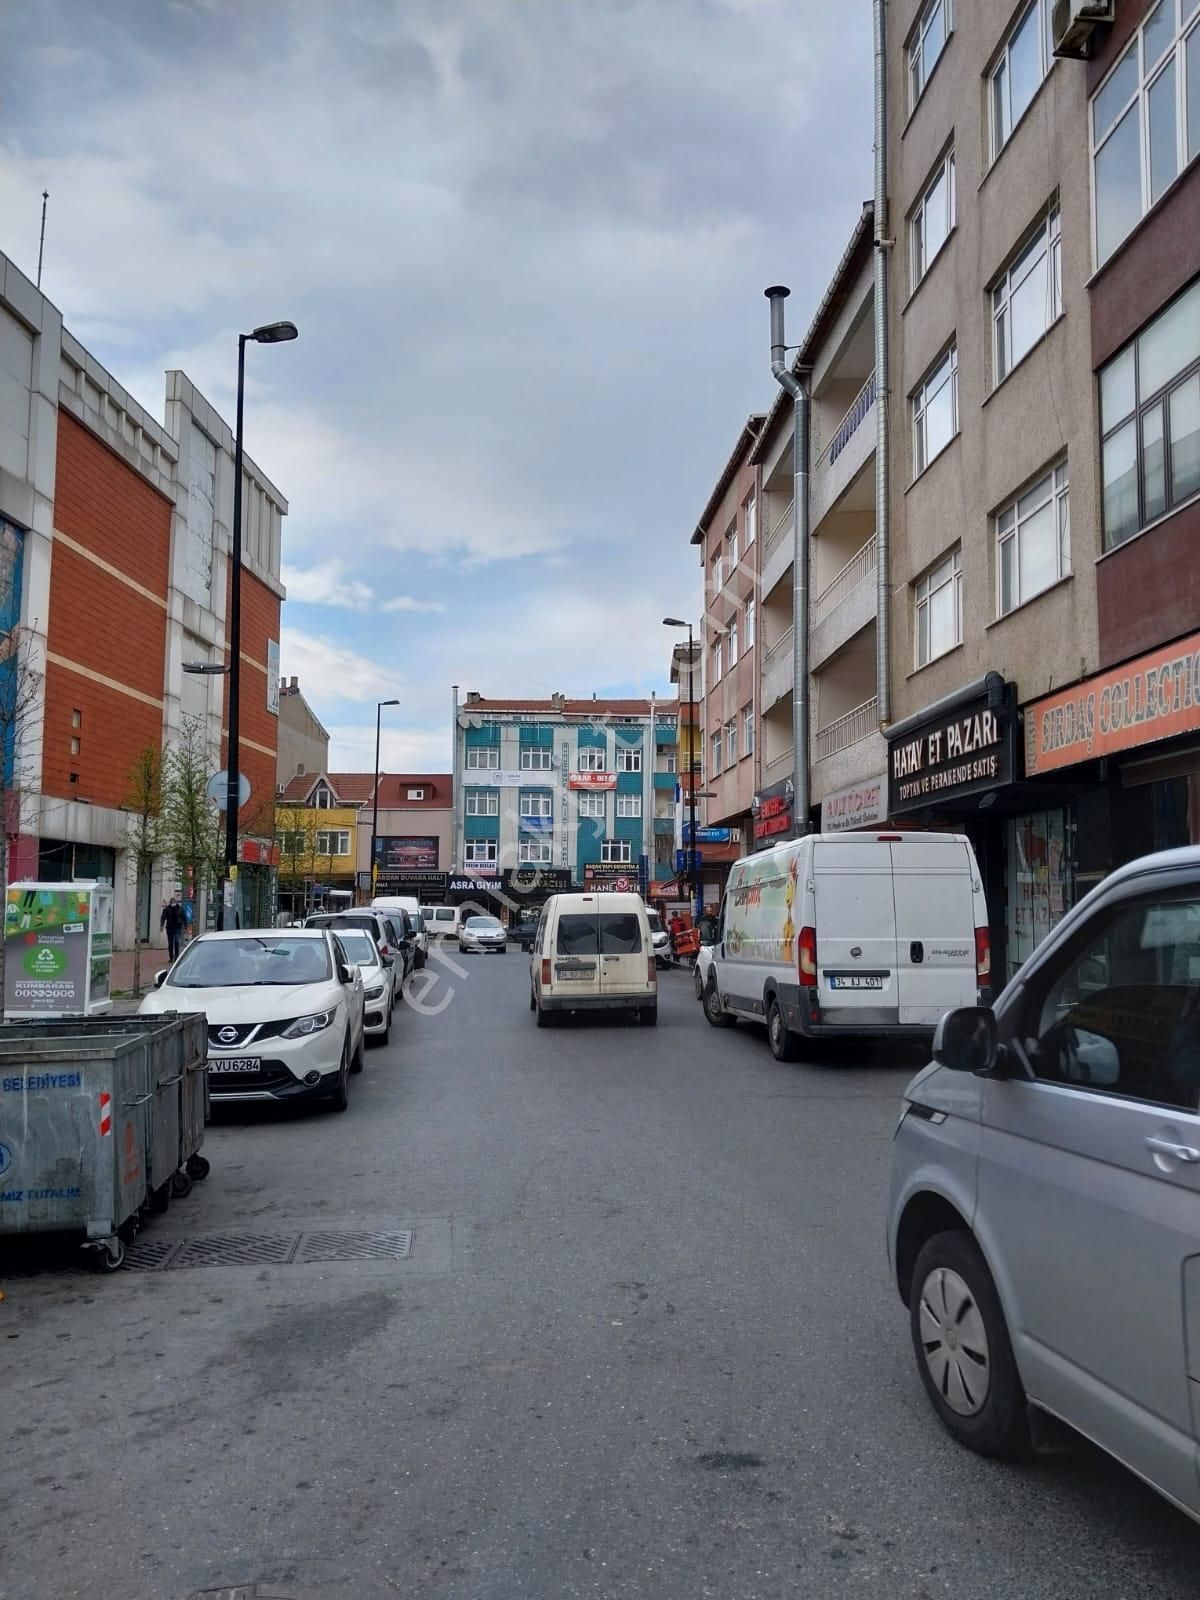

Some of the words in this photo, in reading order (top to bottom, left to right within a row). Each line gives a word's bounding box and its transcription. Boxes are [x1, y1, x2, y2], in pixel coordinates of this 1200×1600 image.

[893, 738, 922, 779] HATAY
[928, 730, 942, 766] ET
[947, 709, 998, 759] PAZARI
[900, 782, 921, 801] TOPTAN
[921, 777, 930, 793] VE
[930, 763, 972, 792] PERAKENDE
[973, 755, 996, 777] SATIŞ
[450, 882, 475, 890] ASRA
[836, 977, 846, 986] 34
